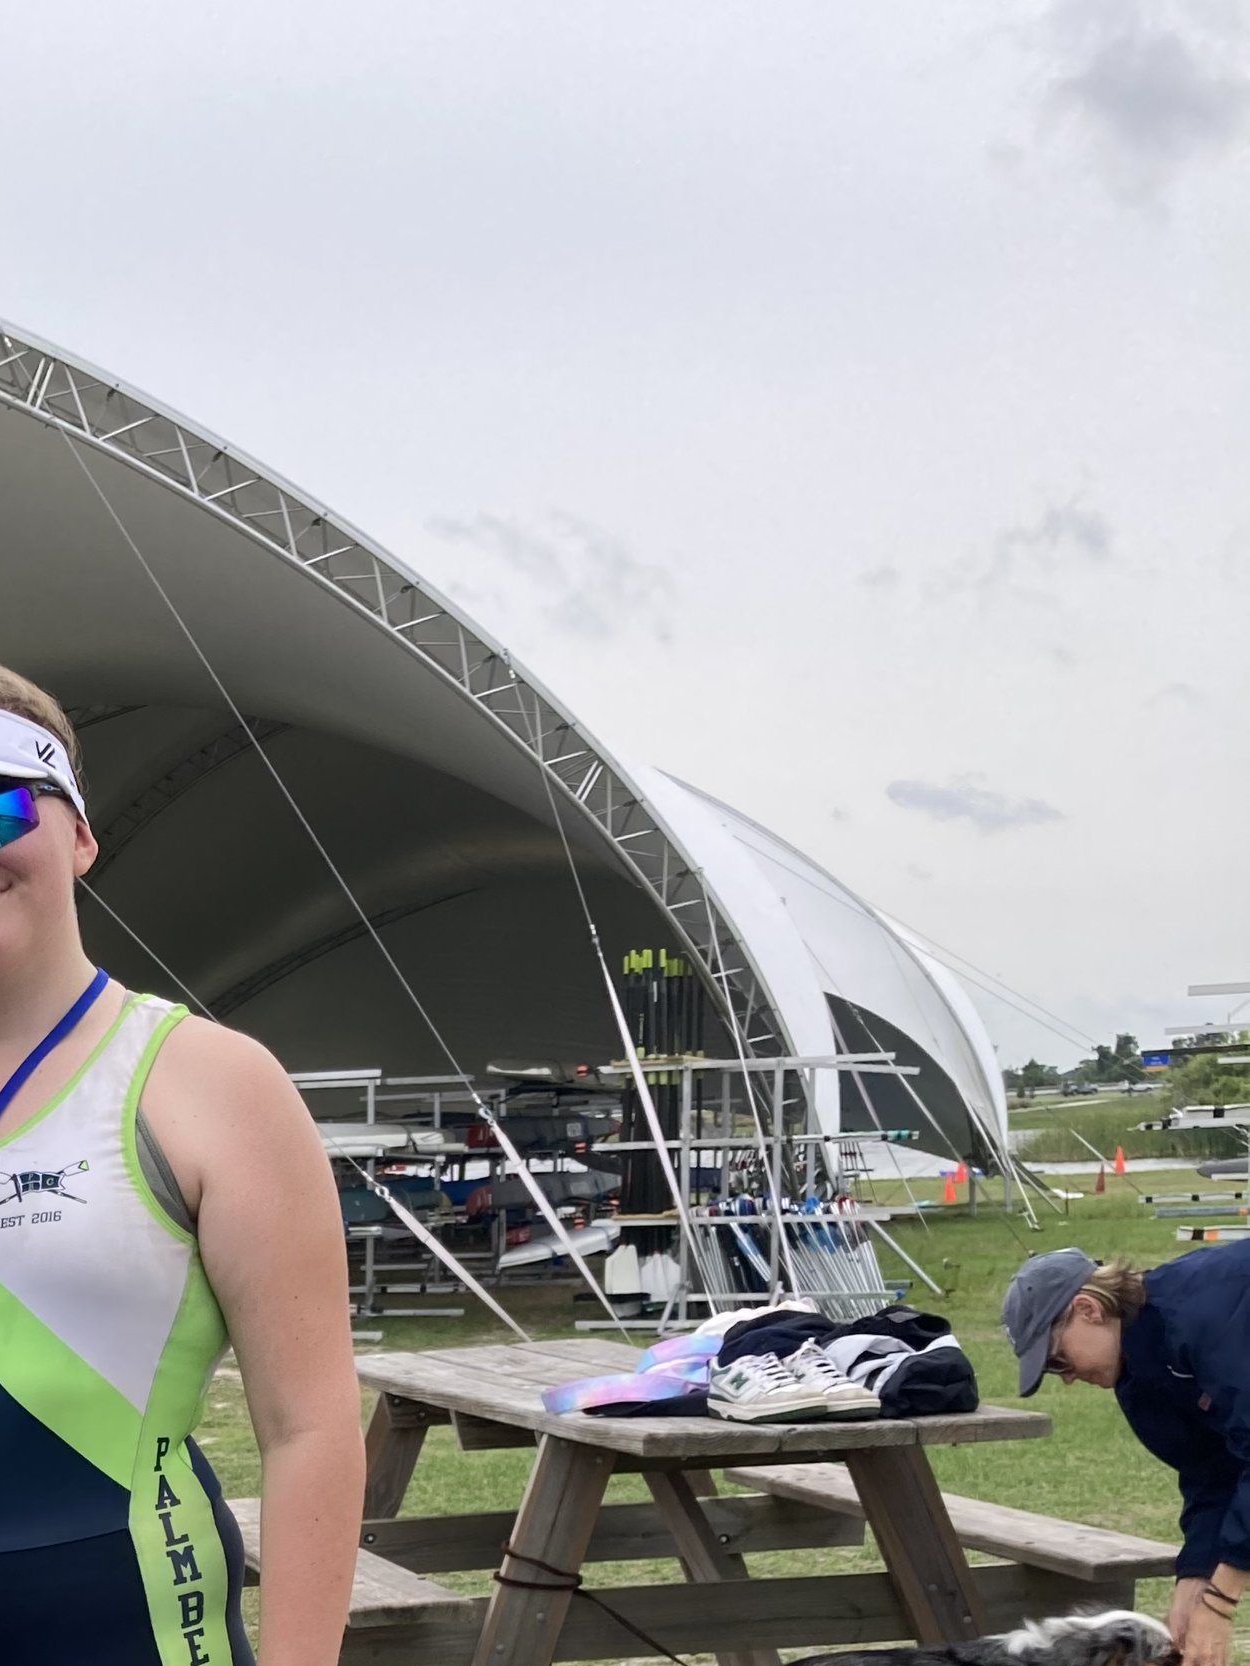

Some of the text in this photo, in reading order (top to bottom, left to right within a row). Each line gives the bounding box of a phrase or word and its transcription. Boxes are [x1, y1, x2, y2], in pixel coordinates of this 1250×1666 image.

[0, 1210, 62, 1229] EST 2016
[153, 1436, 202, 1586] PALM
